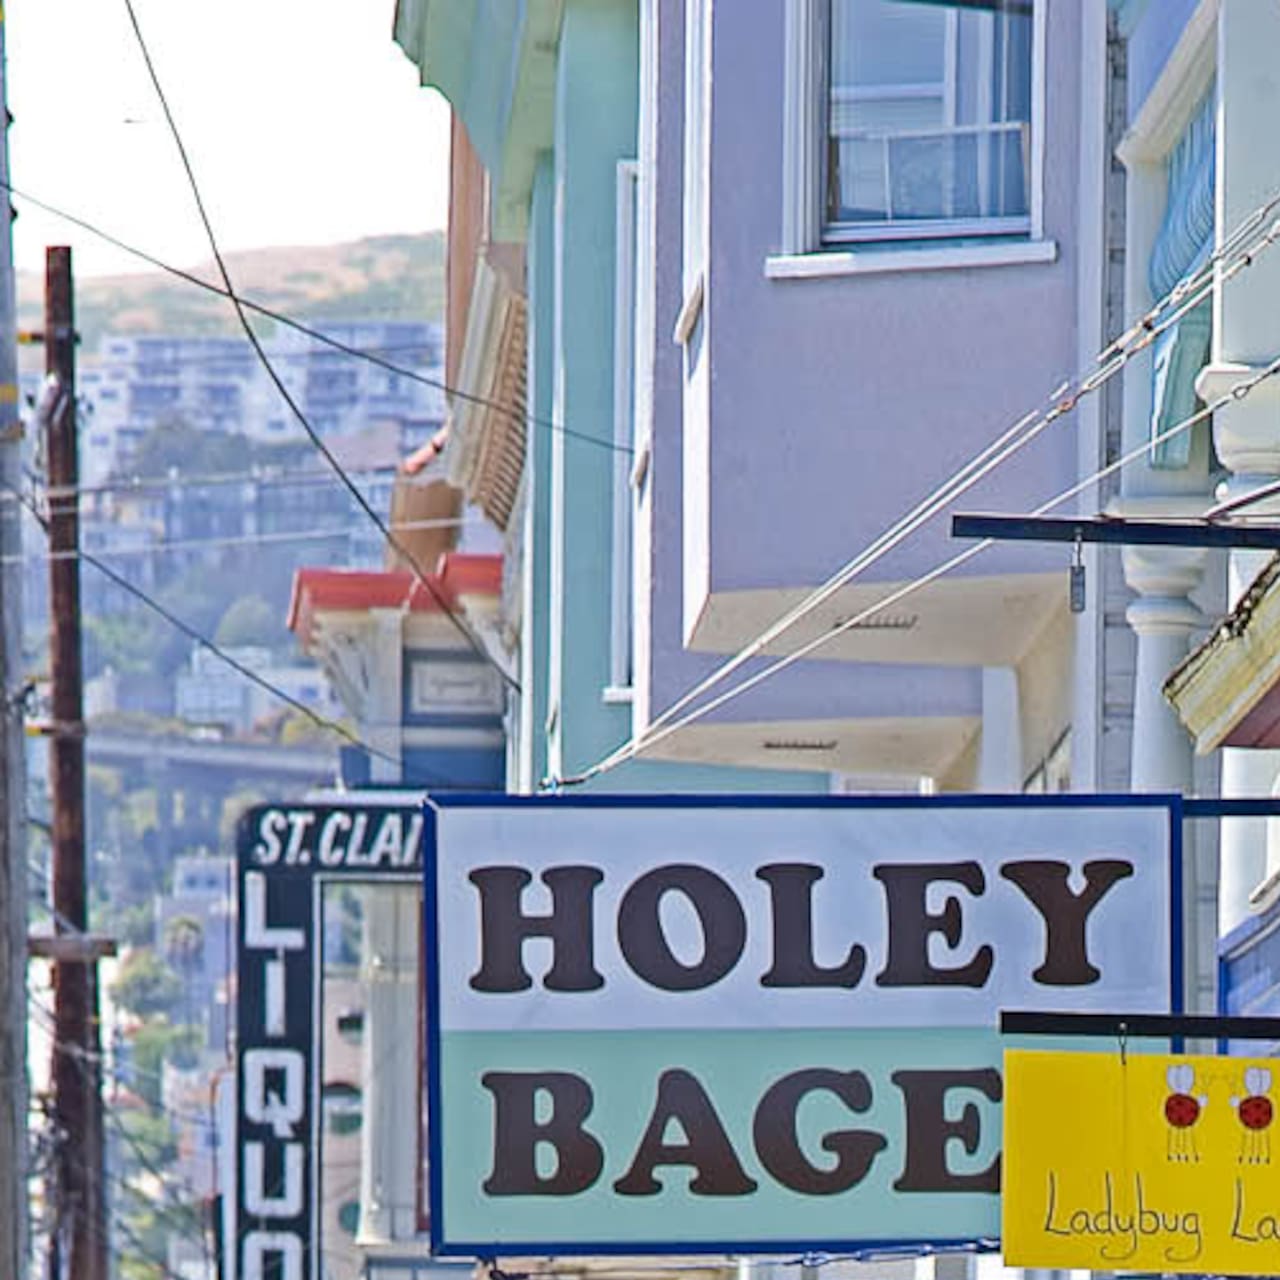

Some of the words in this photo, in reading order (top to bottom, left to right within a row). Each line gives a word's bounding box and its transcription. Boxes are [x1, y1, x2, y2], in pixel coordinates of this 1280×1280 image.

[256, 811, 315, 865] ST.
[319, 812, 424, 866] CLAI
[468, 859, 1135, 994] HOLEY
[481, 1066, 1003, 1197] BAGE
[1043, 1170, 1202, 1262] Ladybug
